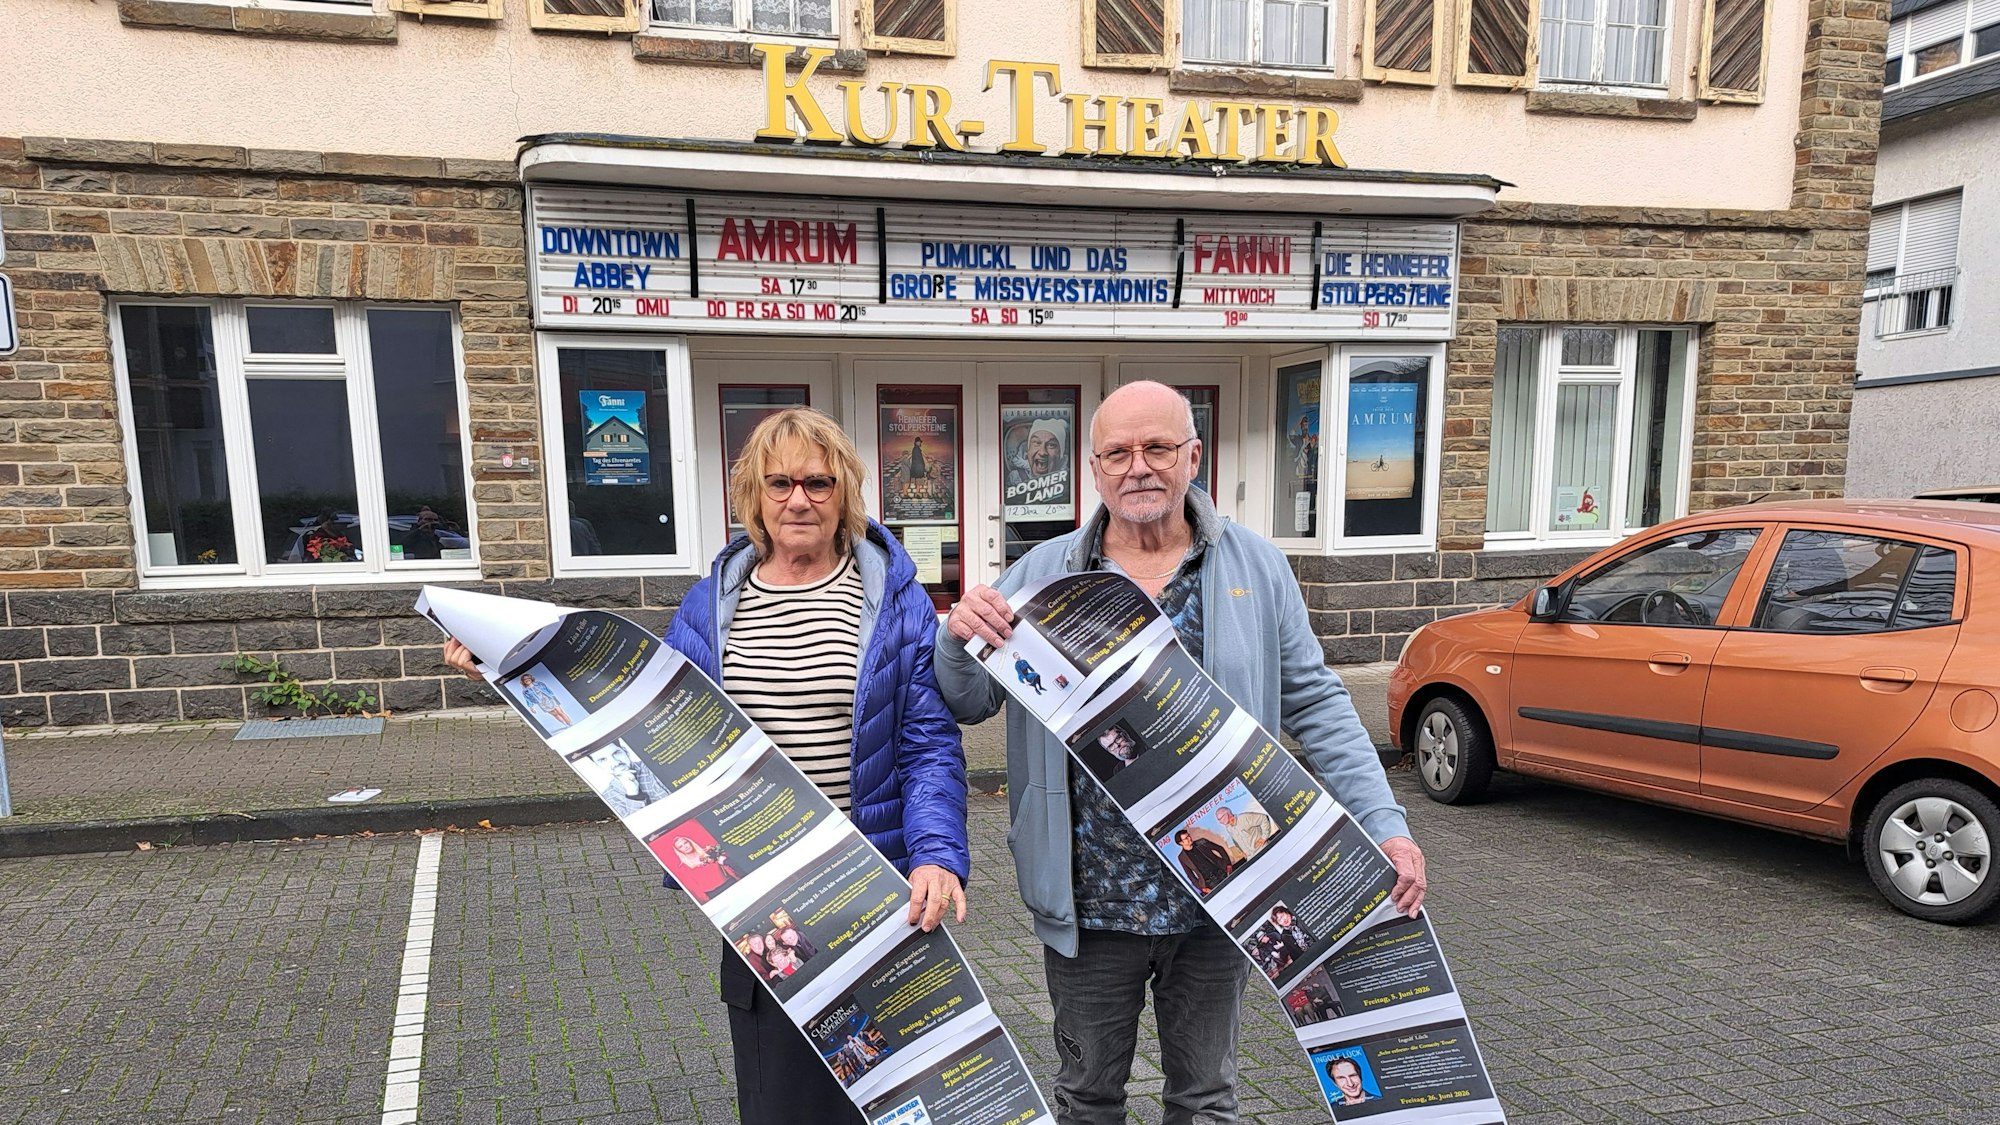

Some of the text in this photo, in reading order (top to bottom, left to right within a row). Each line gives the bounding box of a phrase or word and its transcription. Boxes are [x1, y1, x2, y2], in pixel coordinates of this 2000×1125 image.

[542, 226, 679, 259] DOWNTOWN
[717, 217, 857, 265] AMRUM
[1194, 234, 1291, 274] FANNI
[921, 242, 1128, 272] PUMUCKL UND DAS
[1325, 252, 1449, 278] DIE HENNEFER
[574, 262, 650, 290] ABBEY
[761, 278, 782, 295] SA
[563, 298, 578, 314] DI
[635, 298, 670, 317] OMU
[1204, 288, 1275, 304] MITTWOCH
[707, 301, 726, 317] DO
[736, 301, 754, 319] FR
[761, 301, 782, 320] SA
[786, 302, 806, 320] SO
[814, 304, 835, 320] MO
[971, 308, 989, 324] SA
[1001, 308, 1018, 324] SO
[1364, 312, 1379, 327] SO
[889, 424, 947, 432] STOLPERSTEINE
[1352, 412, 1413, 425] AMRUM
[1007, 470, 1068, 499] BOOMER
[1025, 484, 1064, 504] LAND
[1047, 589, 1072, 609] Carmela
[567, 632, 580, 645] Lisa
[1085, 648, 1110, 666] Freitag,
[1115, 627, 1131, 644] April
[1129, 614, 1146, 630] 2026
[588, 675, 624, 703] Donnerstag,
[627, 649, 642, 668] Januar
[1143, 686, 1158, 702] Jochen
[644, 689, 686, 728] Christoph Kuch
[667, 713, 675, 721] so
[1176, 735, 1200, 756] Freitag,
[1201, 717, 1213, 729] Mai
[671, 727, 741, 788] Freitag, 23. Januar 2026
[1242, 766, 1255, 780] Der
[712, 798, 740, 817] Barbara
[738, 776, 765, 800] Ruscher
[1284, 789, 1306, 812] Freitag,
[1285, 789, 1316, 825] 15. Mai 2026
[1185, 794, 1225, 828] HENNEFER
[748, 844, 774, 861] Freitag,
[777, 821, 802, 841] Februar
[800, 809, 815, 823] 2026
[827, 891, 899, 950] Freitag, 27. Februar 2026
[1332, 889, 1387, 941] Freitag, 29. Mai 2026
[872, 943, 930, 988] Clapton Experience
[889, 976, 897, 984] die
[1363, 997, 1391, 1006] Freitag,
[1398, 989, 1414, 1000] Juni
[1414, 985, 1431, 995] 2026
[811, 1006, 845, 1038] CLAPTON
[818, 1003, 858, 1041] EXPERIENCE
[899, 995, 962, 1036] Freitag, 6. März 2026
[1418, 1041, 1440, 1049] Comedy
[941, 1053, 983, 1080] Björn Heuser
[1315, 1055, 1341, 1064] INGOLF
[896, 1099, 919, 1116] HEUSER
[1400, 1097, 1427, 1105] Freitag,
[1438, 1092, 1454, 1101] Juni
[1453, 1090, 1470, 1098] 2026
[1020, 1108, 1036, 1121] 2026
